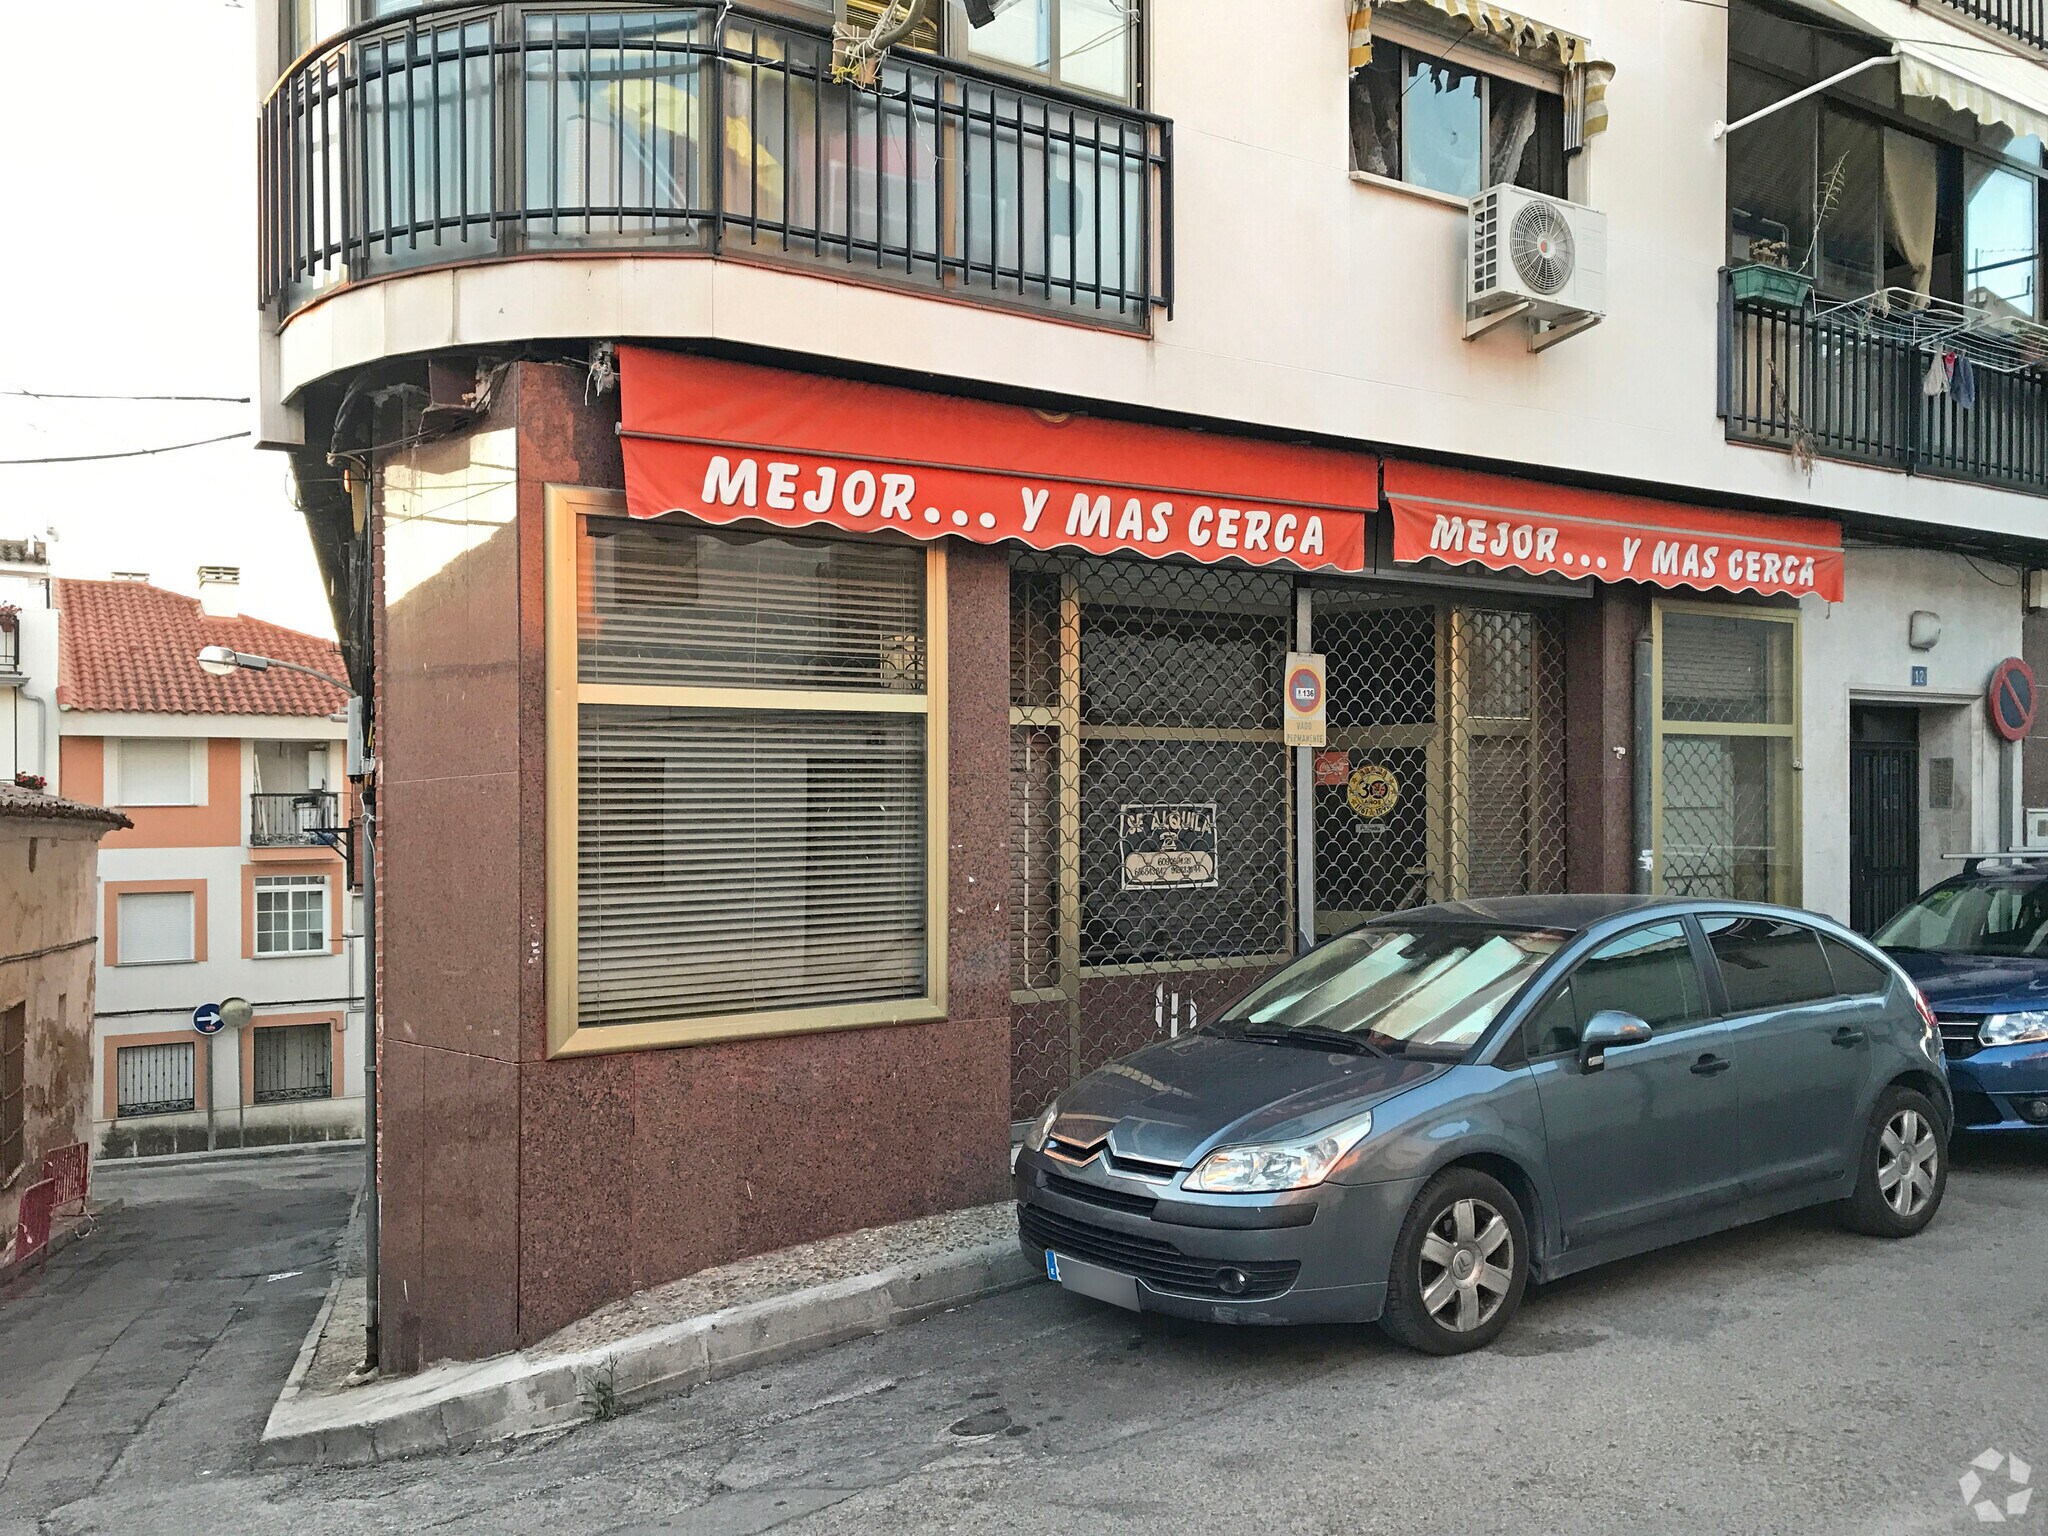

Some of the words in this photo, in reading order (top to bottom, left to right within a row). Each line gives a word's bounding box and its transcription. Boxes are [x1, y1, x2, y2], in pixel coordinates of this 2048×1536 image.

[1021, 486, 1050, 533] Y
[1065, 492, 1174, 543] MAS
[1188, 505, 1325, 555] CERCA
[1622, 536, 1643, 572] Y
[1651, 540, 1720, 579] MAS
[1727, 549, 1816, 587] CERCA
[1915, 670, 1924, 683] 12
[1127, 813, 1144, 834] SE
[1151, 810, 1212, 834] ALQUILA
